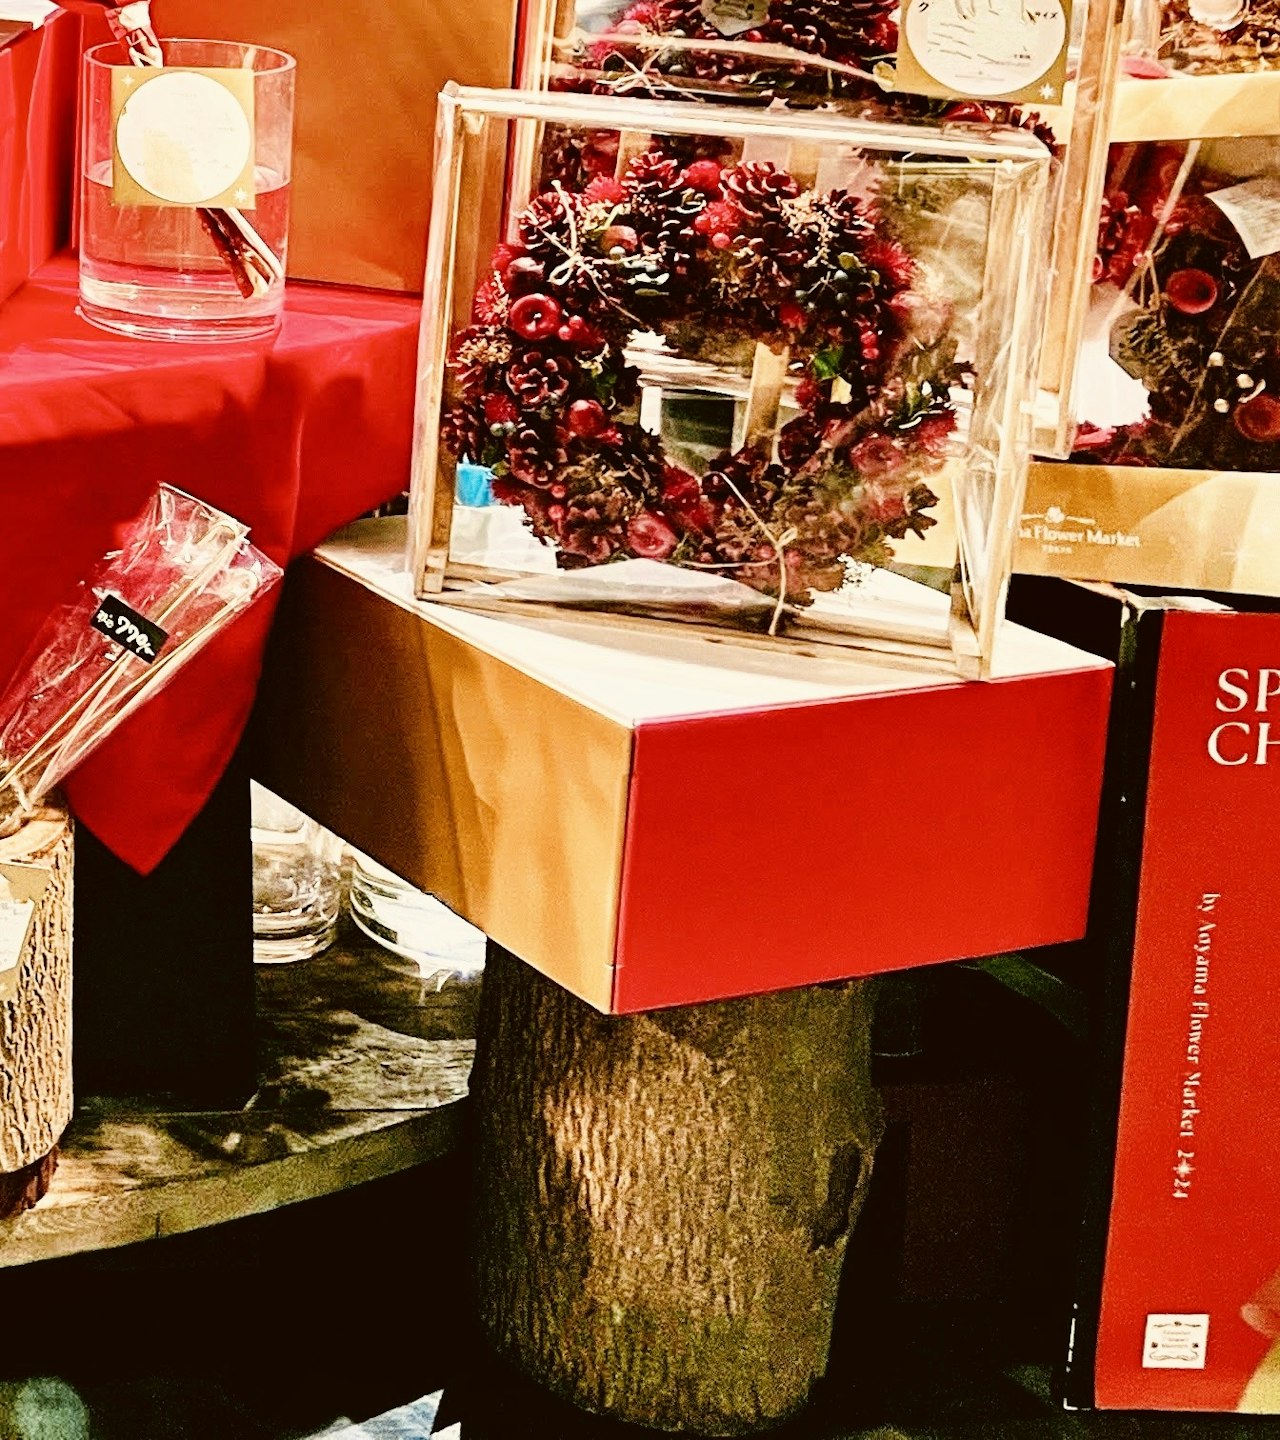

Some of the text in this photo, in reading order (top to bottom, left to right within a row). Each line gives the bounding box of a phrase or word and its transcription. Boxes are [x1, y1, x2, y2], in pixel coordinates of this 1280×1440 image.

[1196, 893, 1221, 912] by
[1193, 921, 1216, 994] Aoyama
[1187, 1001, 1209, 1064] Flower
[1179, 1072, 1201, 1137] Market
